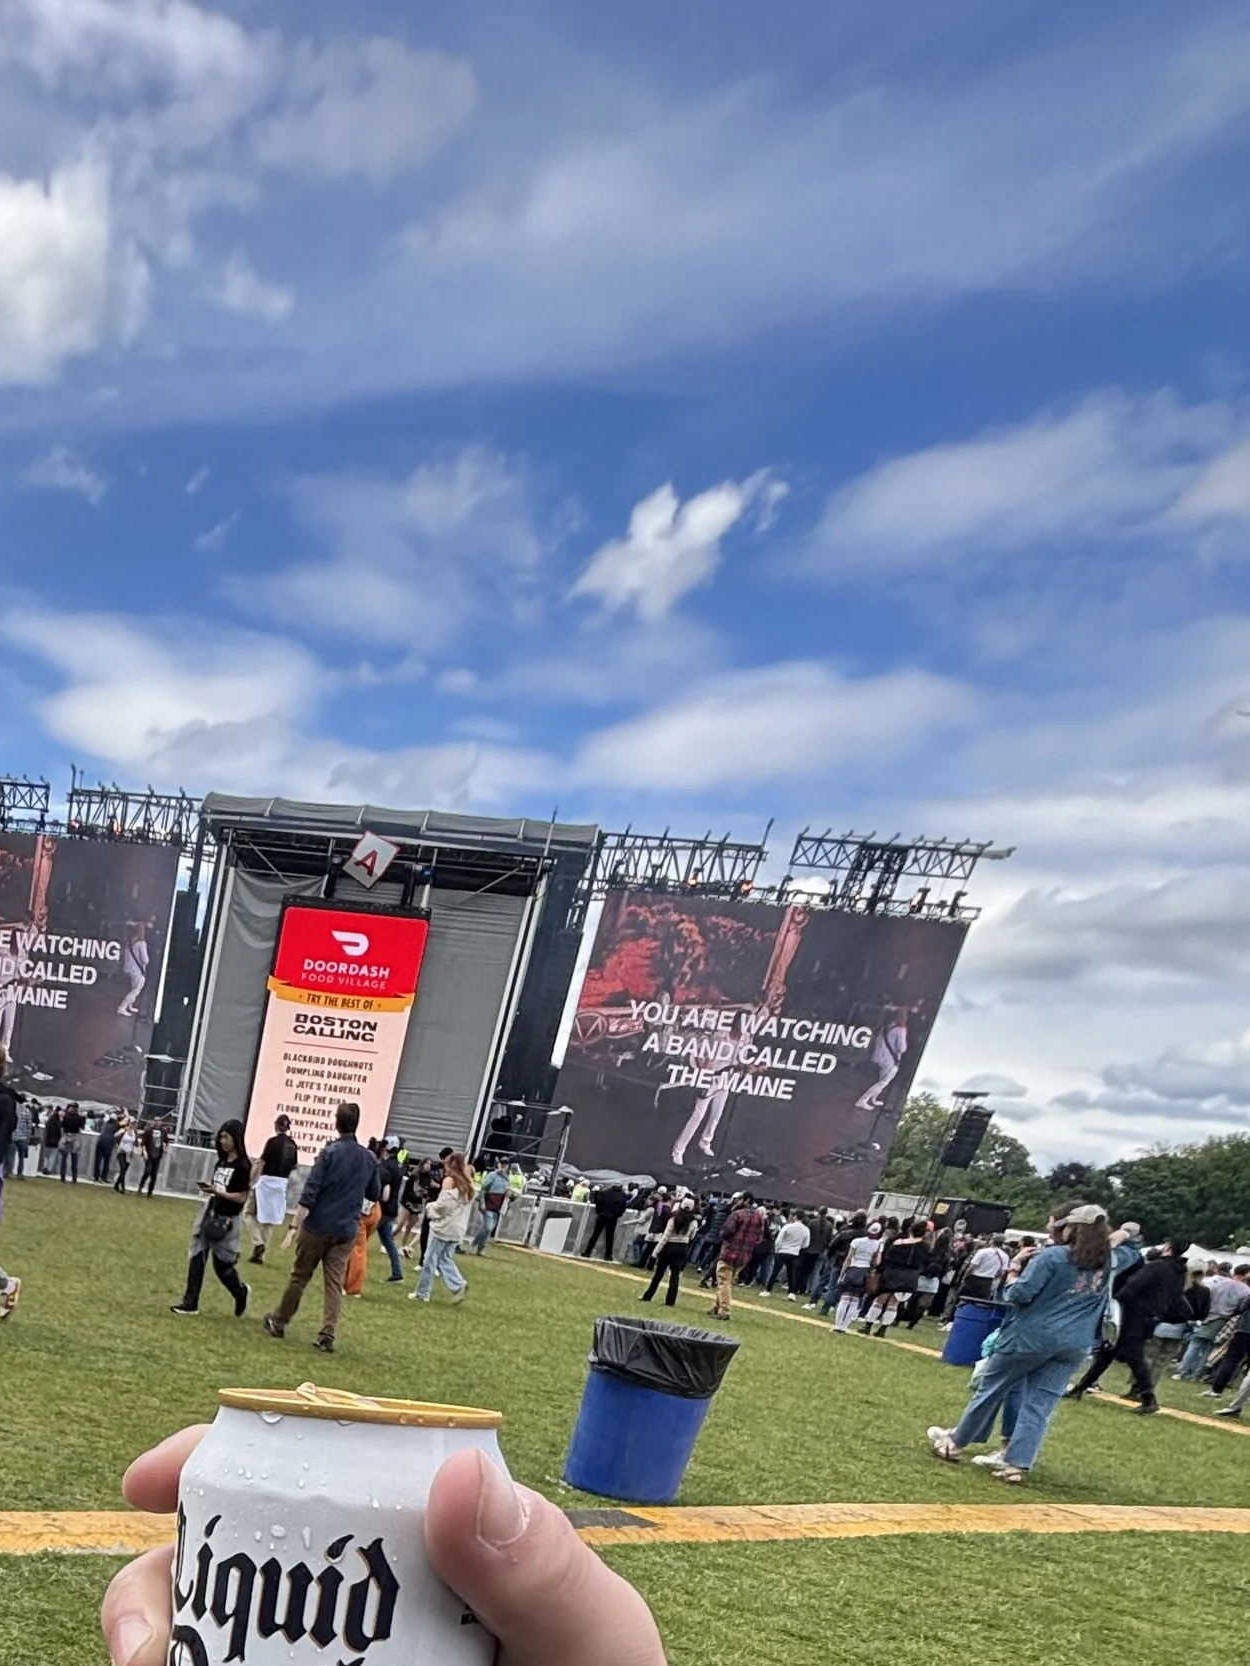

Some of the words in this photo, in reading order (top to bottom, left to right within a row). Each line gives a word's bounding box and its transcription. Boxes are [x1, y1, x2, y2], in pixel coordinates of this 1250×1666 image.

[353, 849, 378, 877] A
[15, 932, 121, 961] WATCHING
[18, 960, 98, 985] CALLED
[304, 959, 390, 979] DOORDASH
[301, 972, 334, 984] FOOD
[338, 976, 387, 989] VILLAGE
[6, 983, 68, 1009] MAINE
[306, 993, 322, 1004] TRY
[324, 995, 338, 1007] THE
[341, 997, 361, 1009] BEST
[363, 999, 375, 1010] OF
[295, 1013, 378, 1032] BOSTON
[629, 1000, 679, 1024] YOU
[682, 1007, 736, 1032] ARE
[740, 1013, 873, 1049] WATCHING
[293, 1024, 375, 1042] CALLING
[283, 1052, 326, 1066] BLACKBIRD
[327, 1057, 374, 1071] DOUGHNUTS
[642, 1033, 660, 1052] A
[665, 1035, 736, 1062] BAND
[738, 1044, 838, 1075] CALLED
[286, 1065, 325, 1079] DUMPLING
[327, 1069, 368, 1083] DAUGHTER
[666, 1064, 713, 1089] THE
[717, 1069, 797, 1101] MAINE
[285, 1079, 294, 1088] EL
[295, 1080, 322, 1091] JEFE'S
[323, 1083, 361, 1096] TAQUERIA
[294, 1093, 311, 1102] FLIP
[313, 1094, 327, 1105] THE
[276, 1103, 300, 1114] FLOUR
[301, 1105, 332, 1118] BAKERY
[172, 1499, 400, 1664] Liquid
